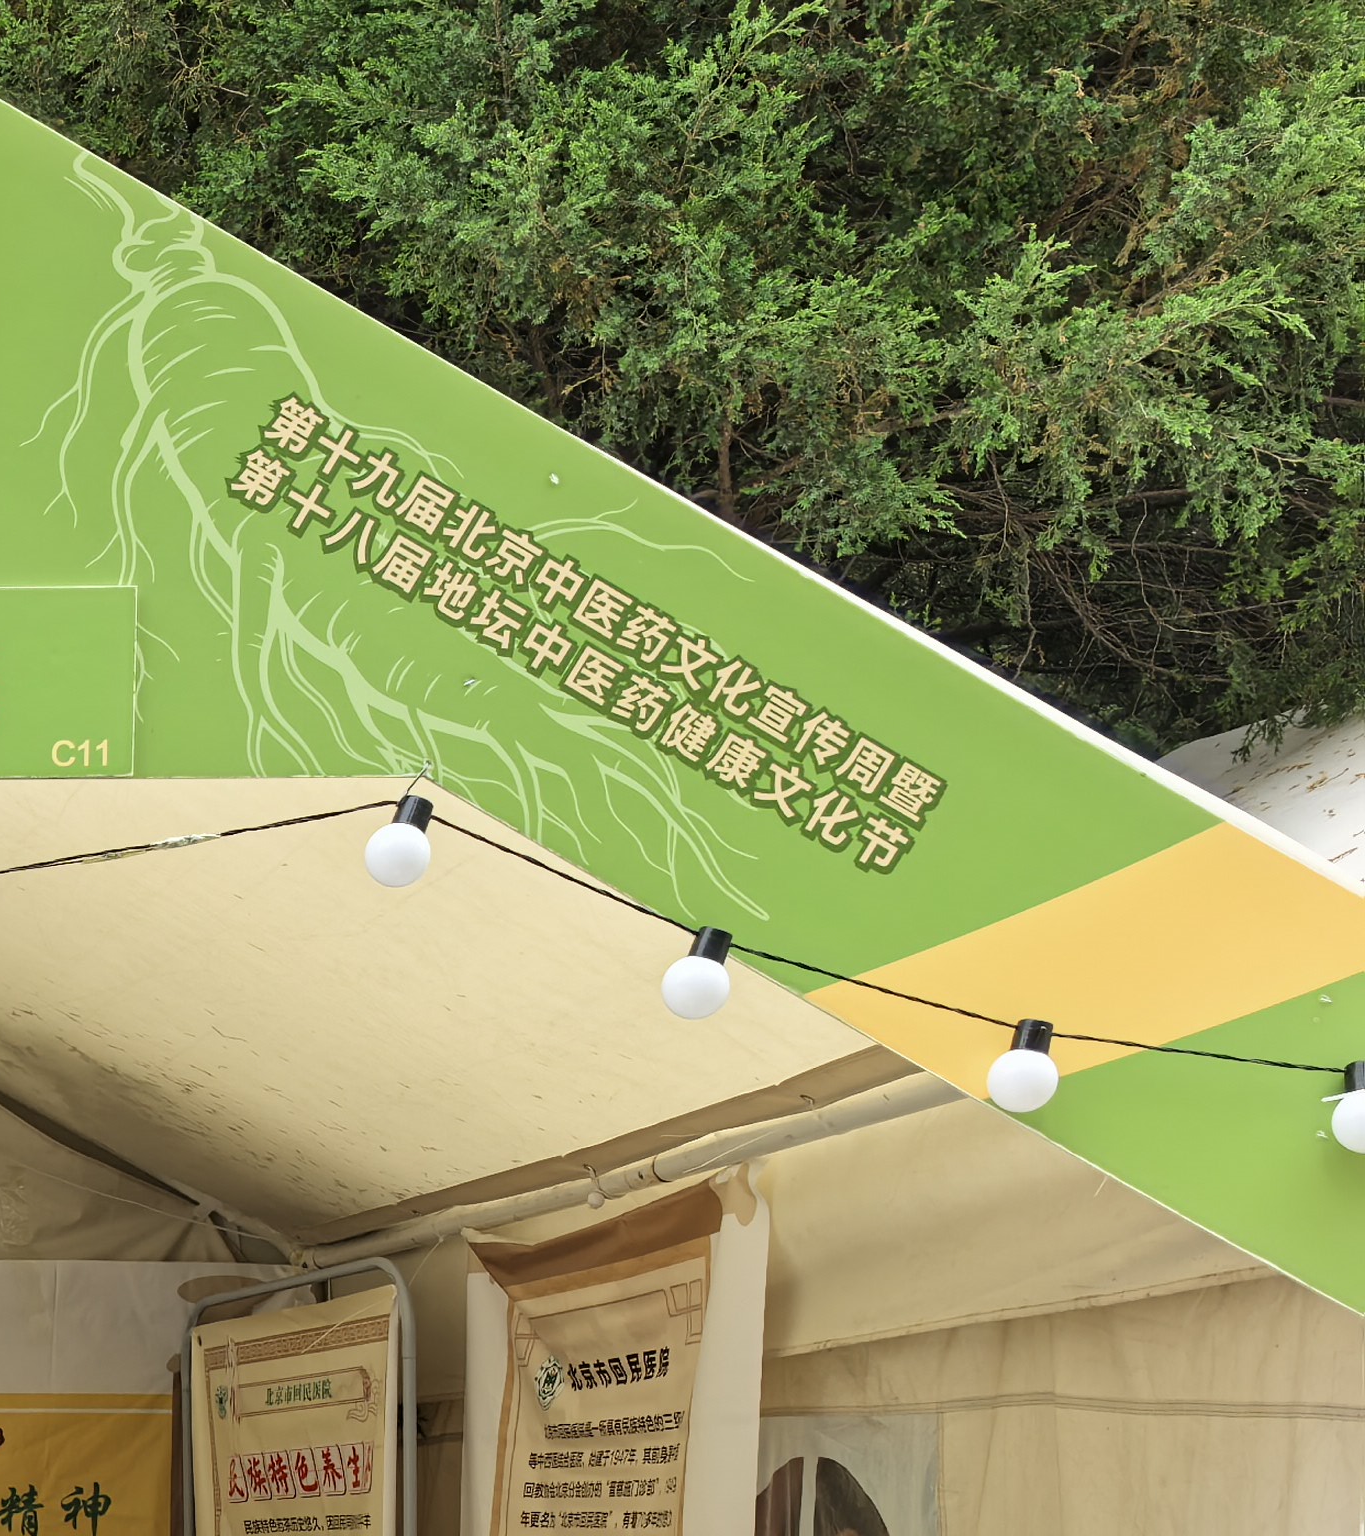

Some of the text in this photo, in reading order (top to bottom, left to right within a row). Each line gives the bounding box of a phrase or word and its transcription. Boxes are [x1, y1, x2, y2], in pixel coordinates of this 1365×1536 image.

[229, 450, 911, 874] 第十八届地坛中医药健康文化节
[262, 398, 944, 826] 第十九届北京中医药文化宣传周暨
[50, 739, 112, 770] C11
[567, 1346, 671, 1392] 北京市回民医院
